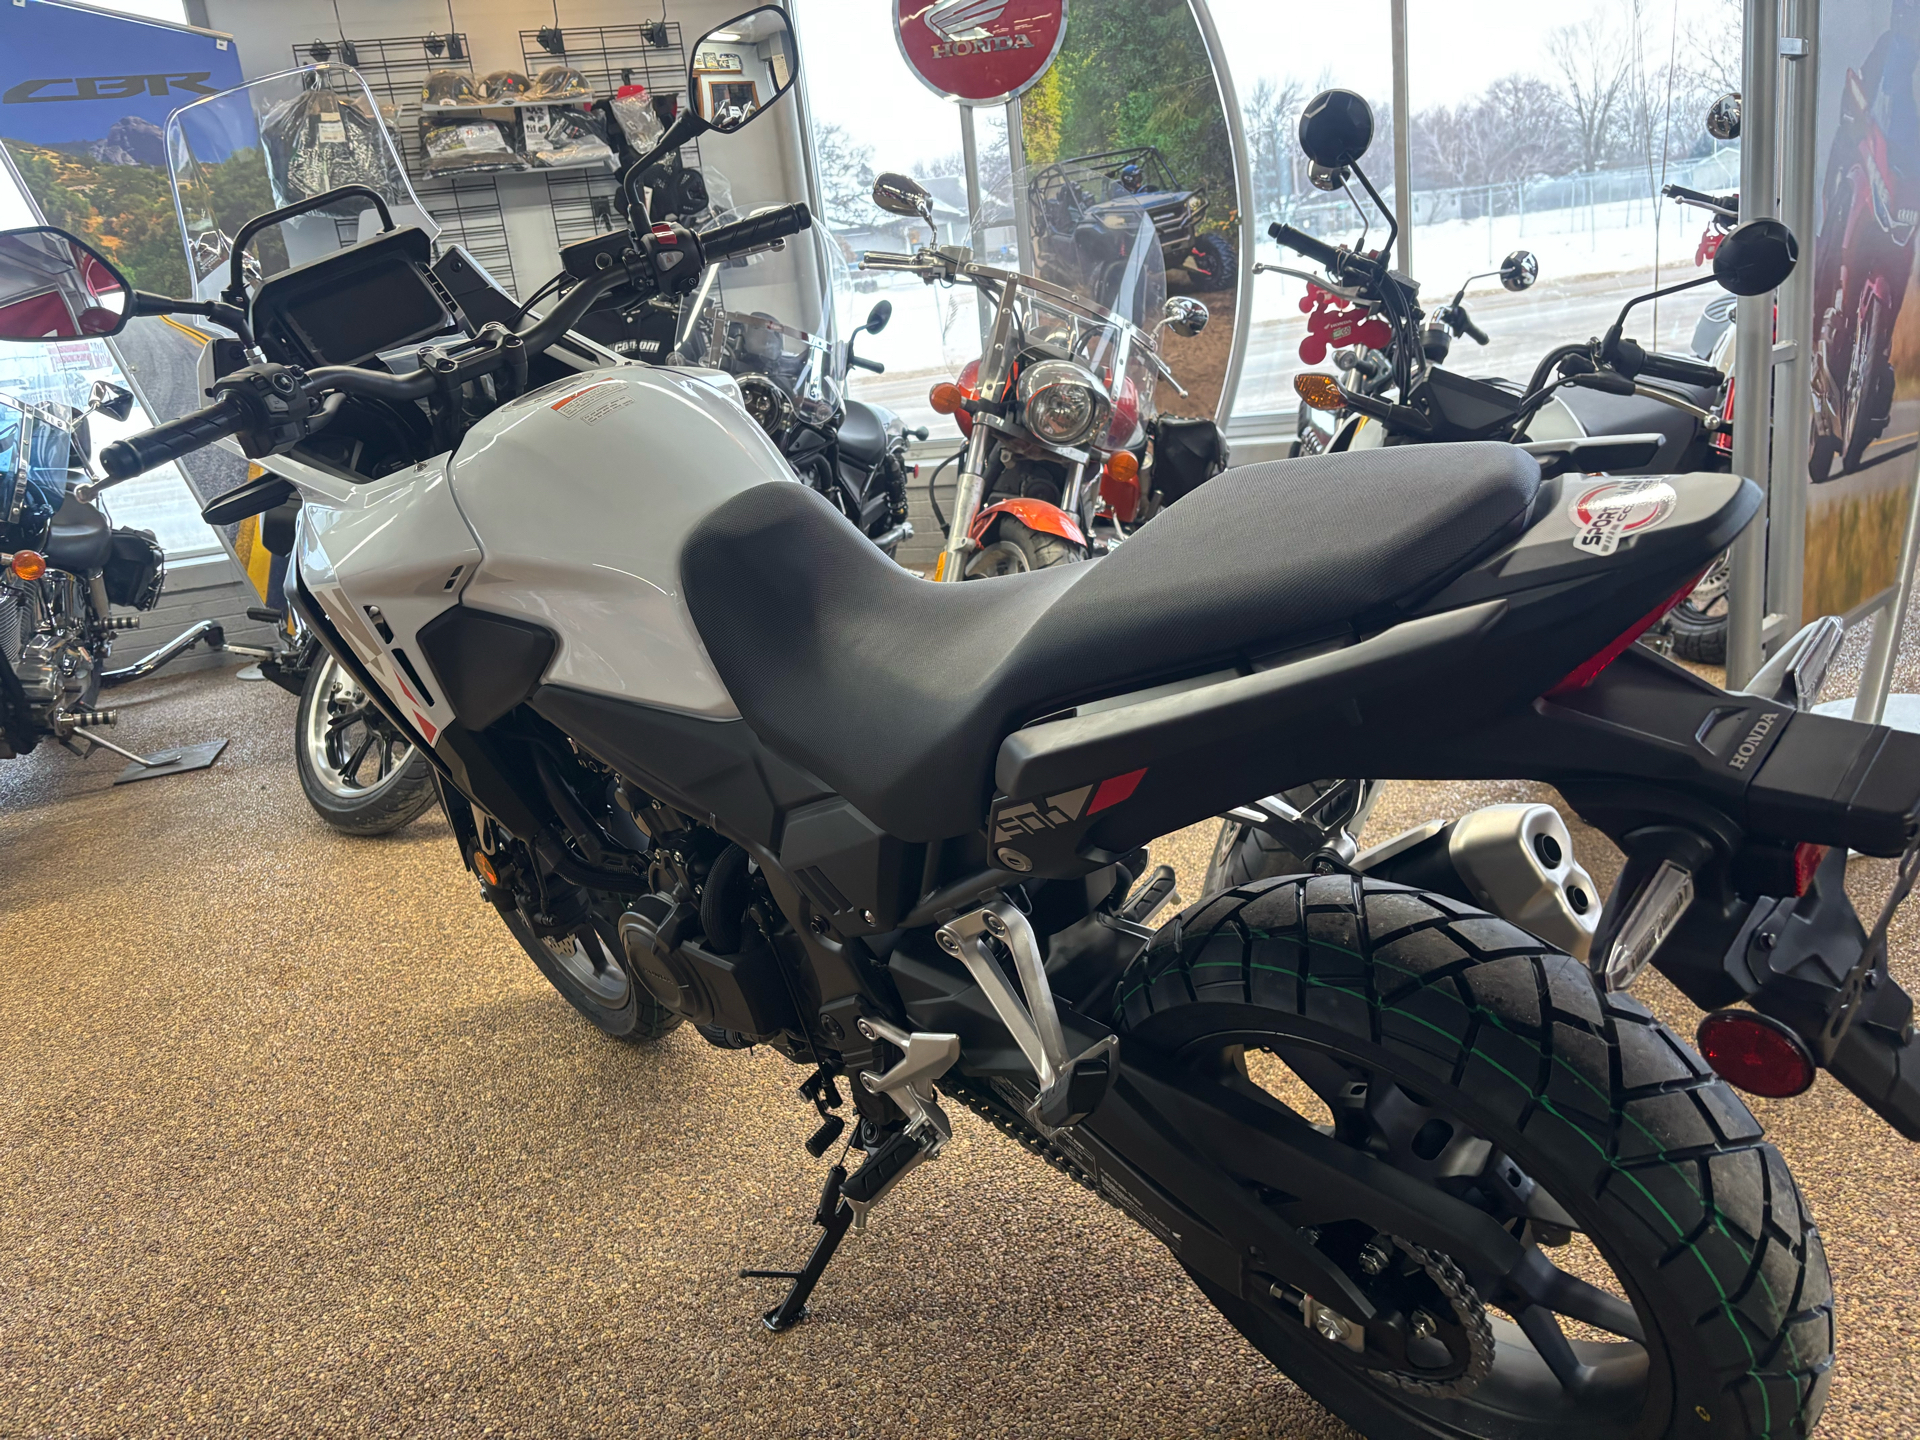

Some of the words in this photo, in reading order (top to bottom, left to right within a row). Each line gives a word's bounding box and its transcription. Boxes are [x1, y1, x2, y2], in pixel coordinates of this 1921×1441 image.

[931, 33, 1035, 59] HONDA
[3, 71, 220, 104] CBR
[1728, 713, 1779, 770] HONDA
